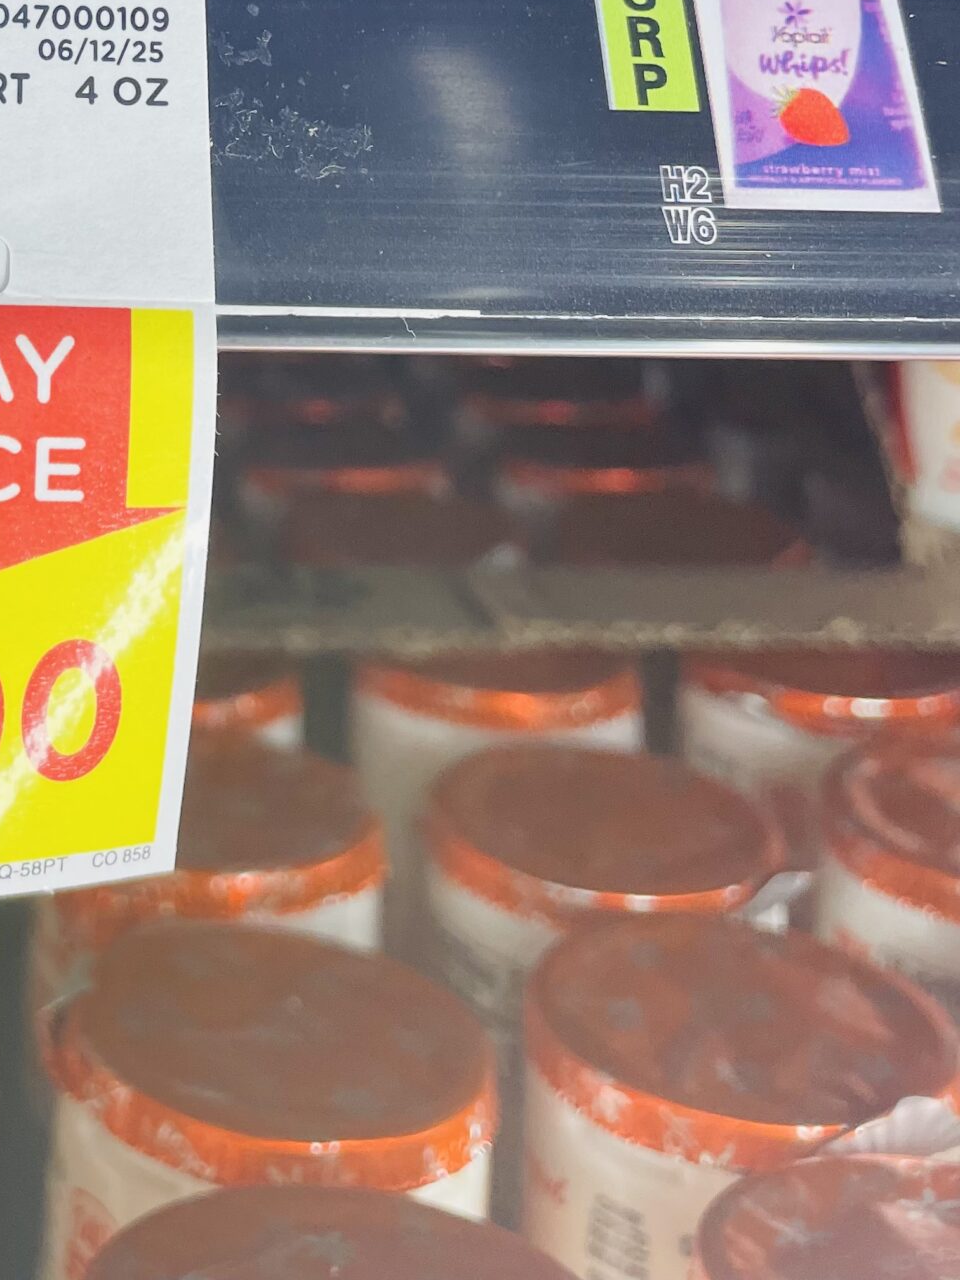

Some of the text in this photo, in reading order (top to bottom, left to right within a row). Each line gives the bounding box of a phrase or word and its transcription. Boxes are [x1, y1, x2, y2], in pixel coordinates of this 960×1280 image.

[37, 37, 164, 66] 06/12/25
[770, 26, 833, 48] Yoplait
[74, 76, 99, 105] 4
[112, 77, 170, 107] OZ
[658, 165, 712, 203] H2
[661, 206, 717, 245] W6
[122, 845, 152, 863] 858
